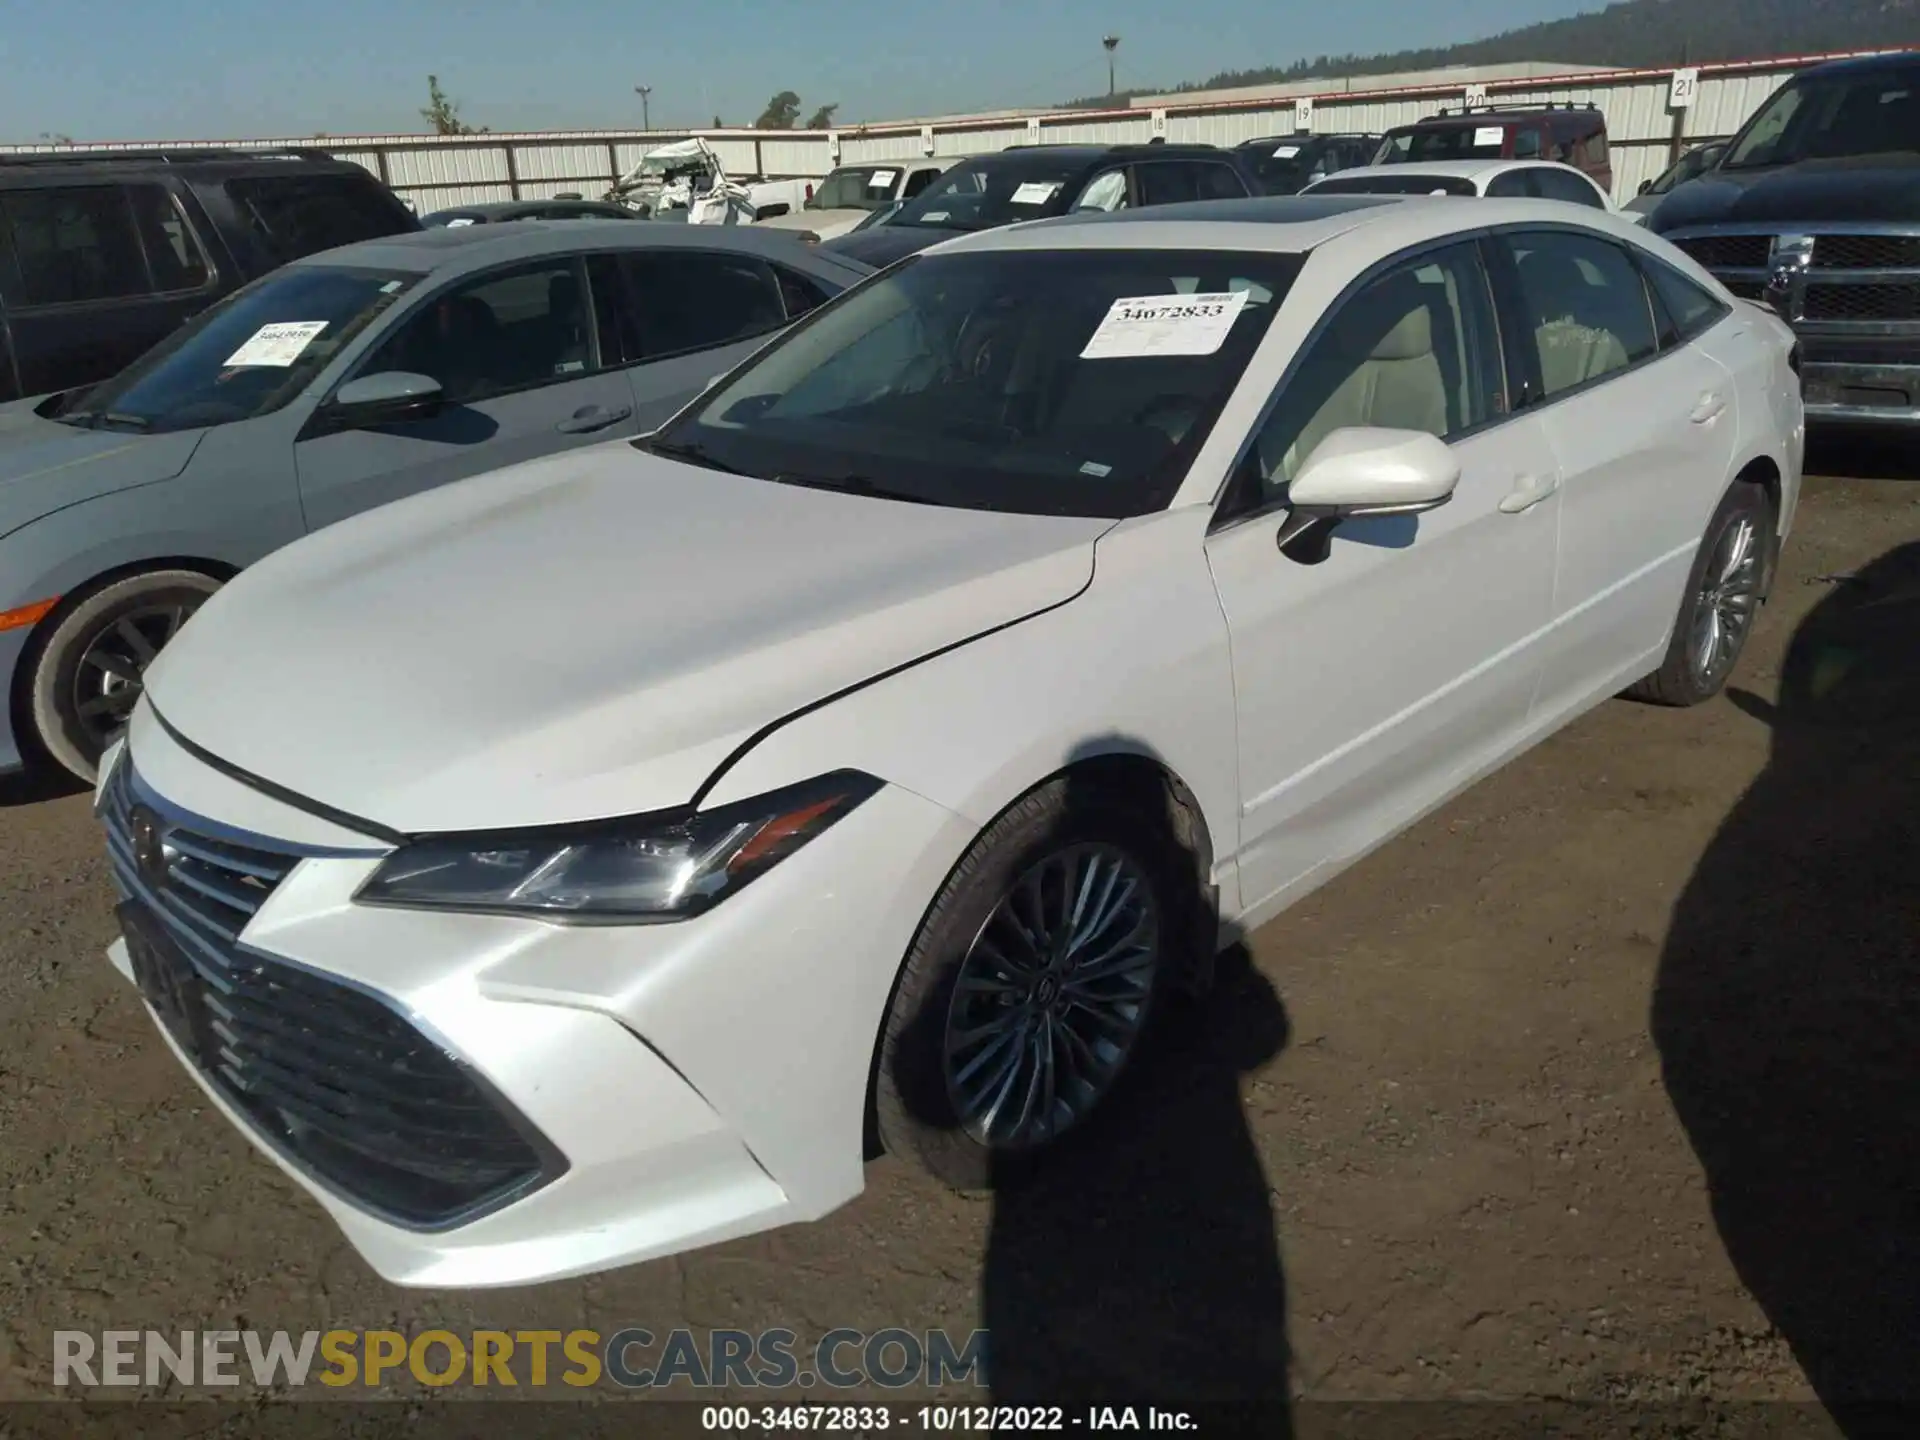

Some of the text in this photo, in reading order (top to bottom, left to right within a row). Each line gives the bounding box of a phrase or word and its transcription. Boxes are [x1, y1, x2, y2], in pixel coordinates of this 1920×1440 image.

[1674, 78, 1693, 97] 21
[1467, 94, 1485, 107] 20
[1298, 106, 1310, 121] 19
[1153, 117, 1164, 130] 18
